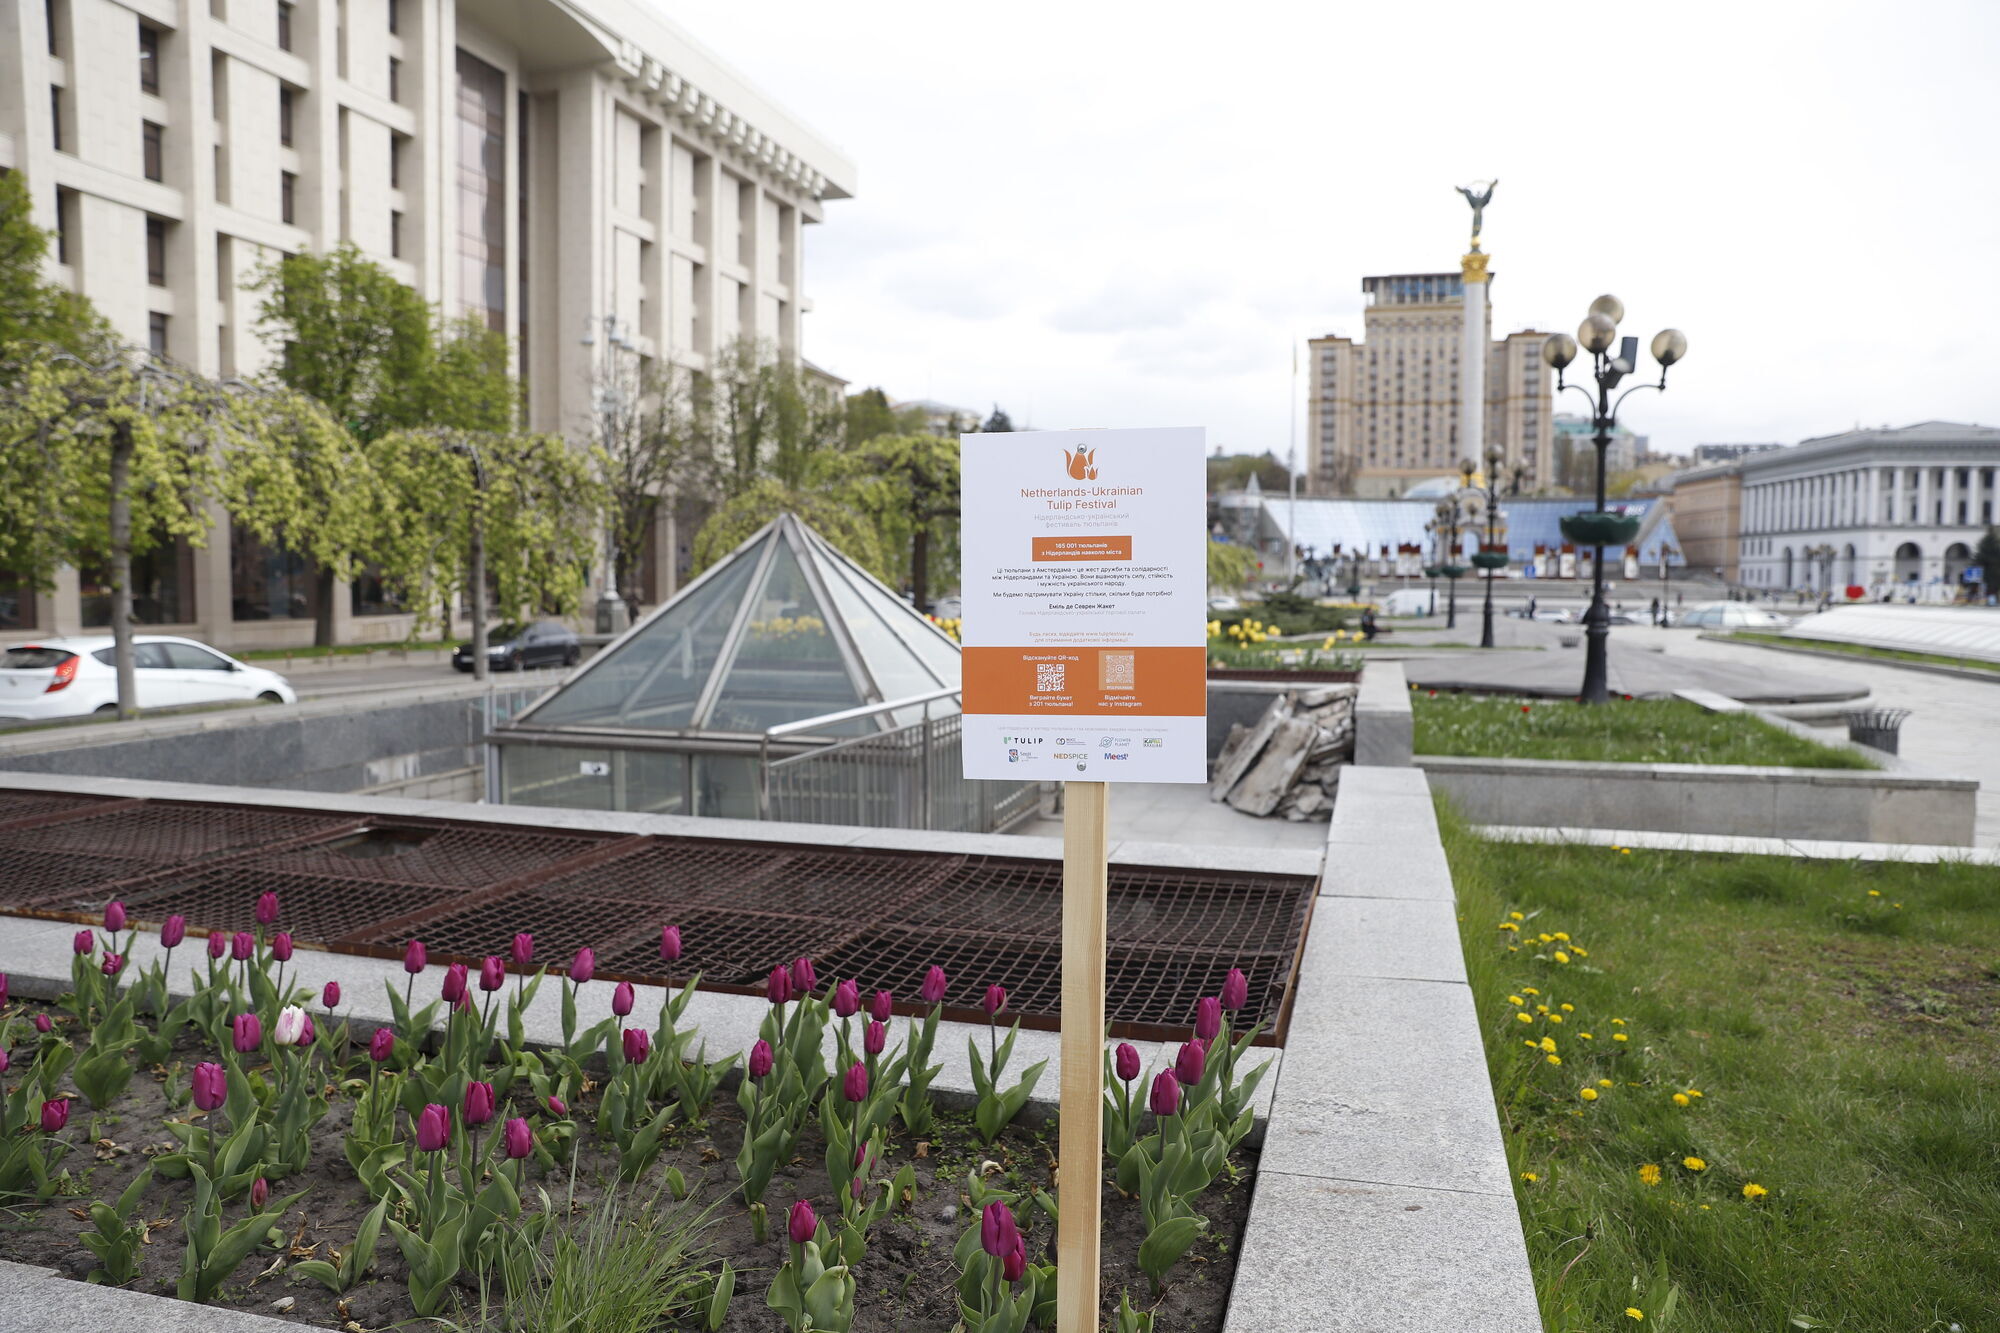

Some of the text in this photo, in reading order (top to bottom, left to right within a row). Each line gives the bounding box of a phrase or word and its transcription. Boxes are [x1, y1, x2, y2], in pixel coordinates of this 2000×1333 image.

[1021, 486, 1143, 498] Netherlands-Ukrainian
[1047, 499, 1117, 511] Tulip Festival
